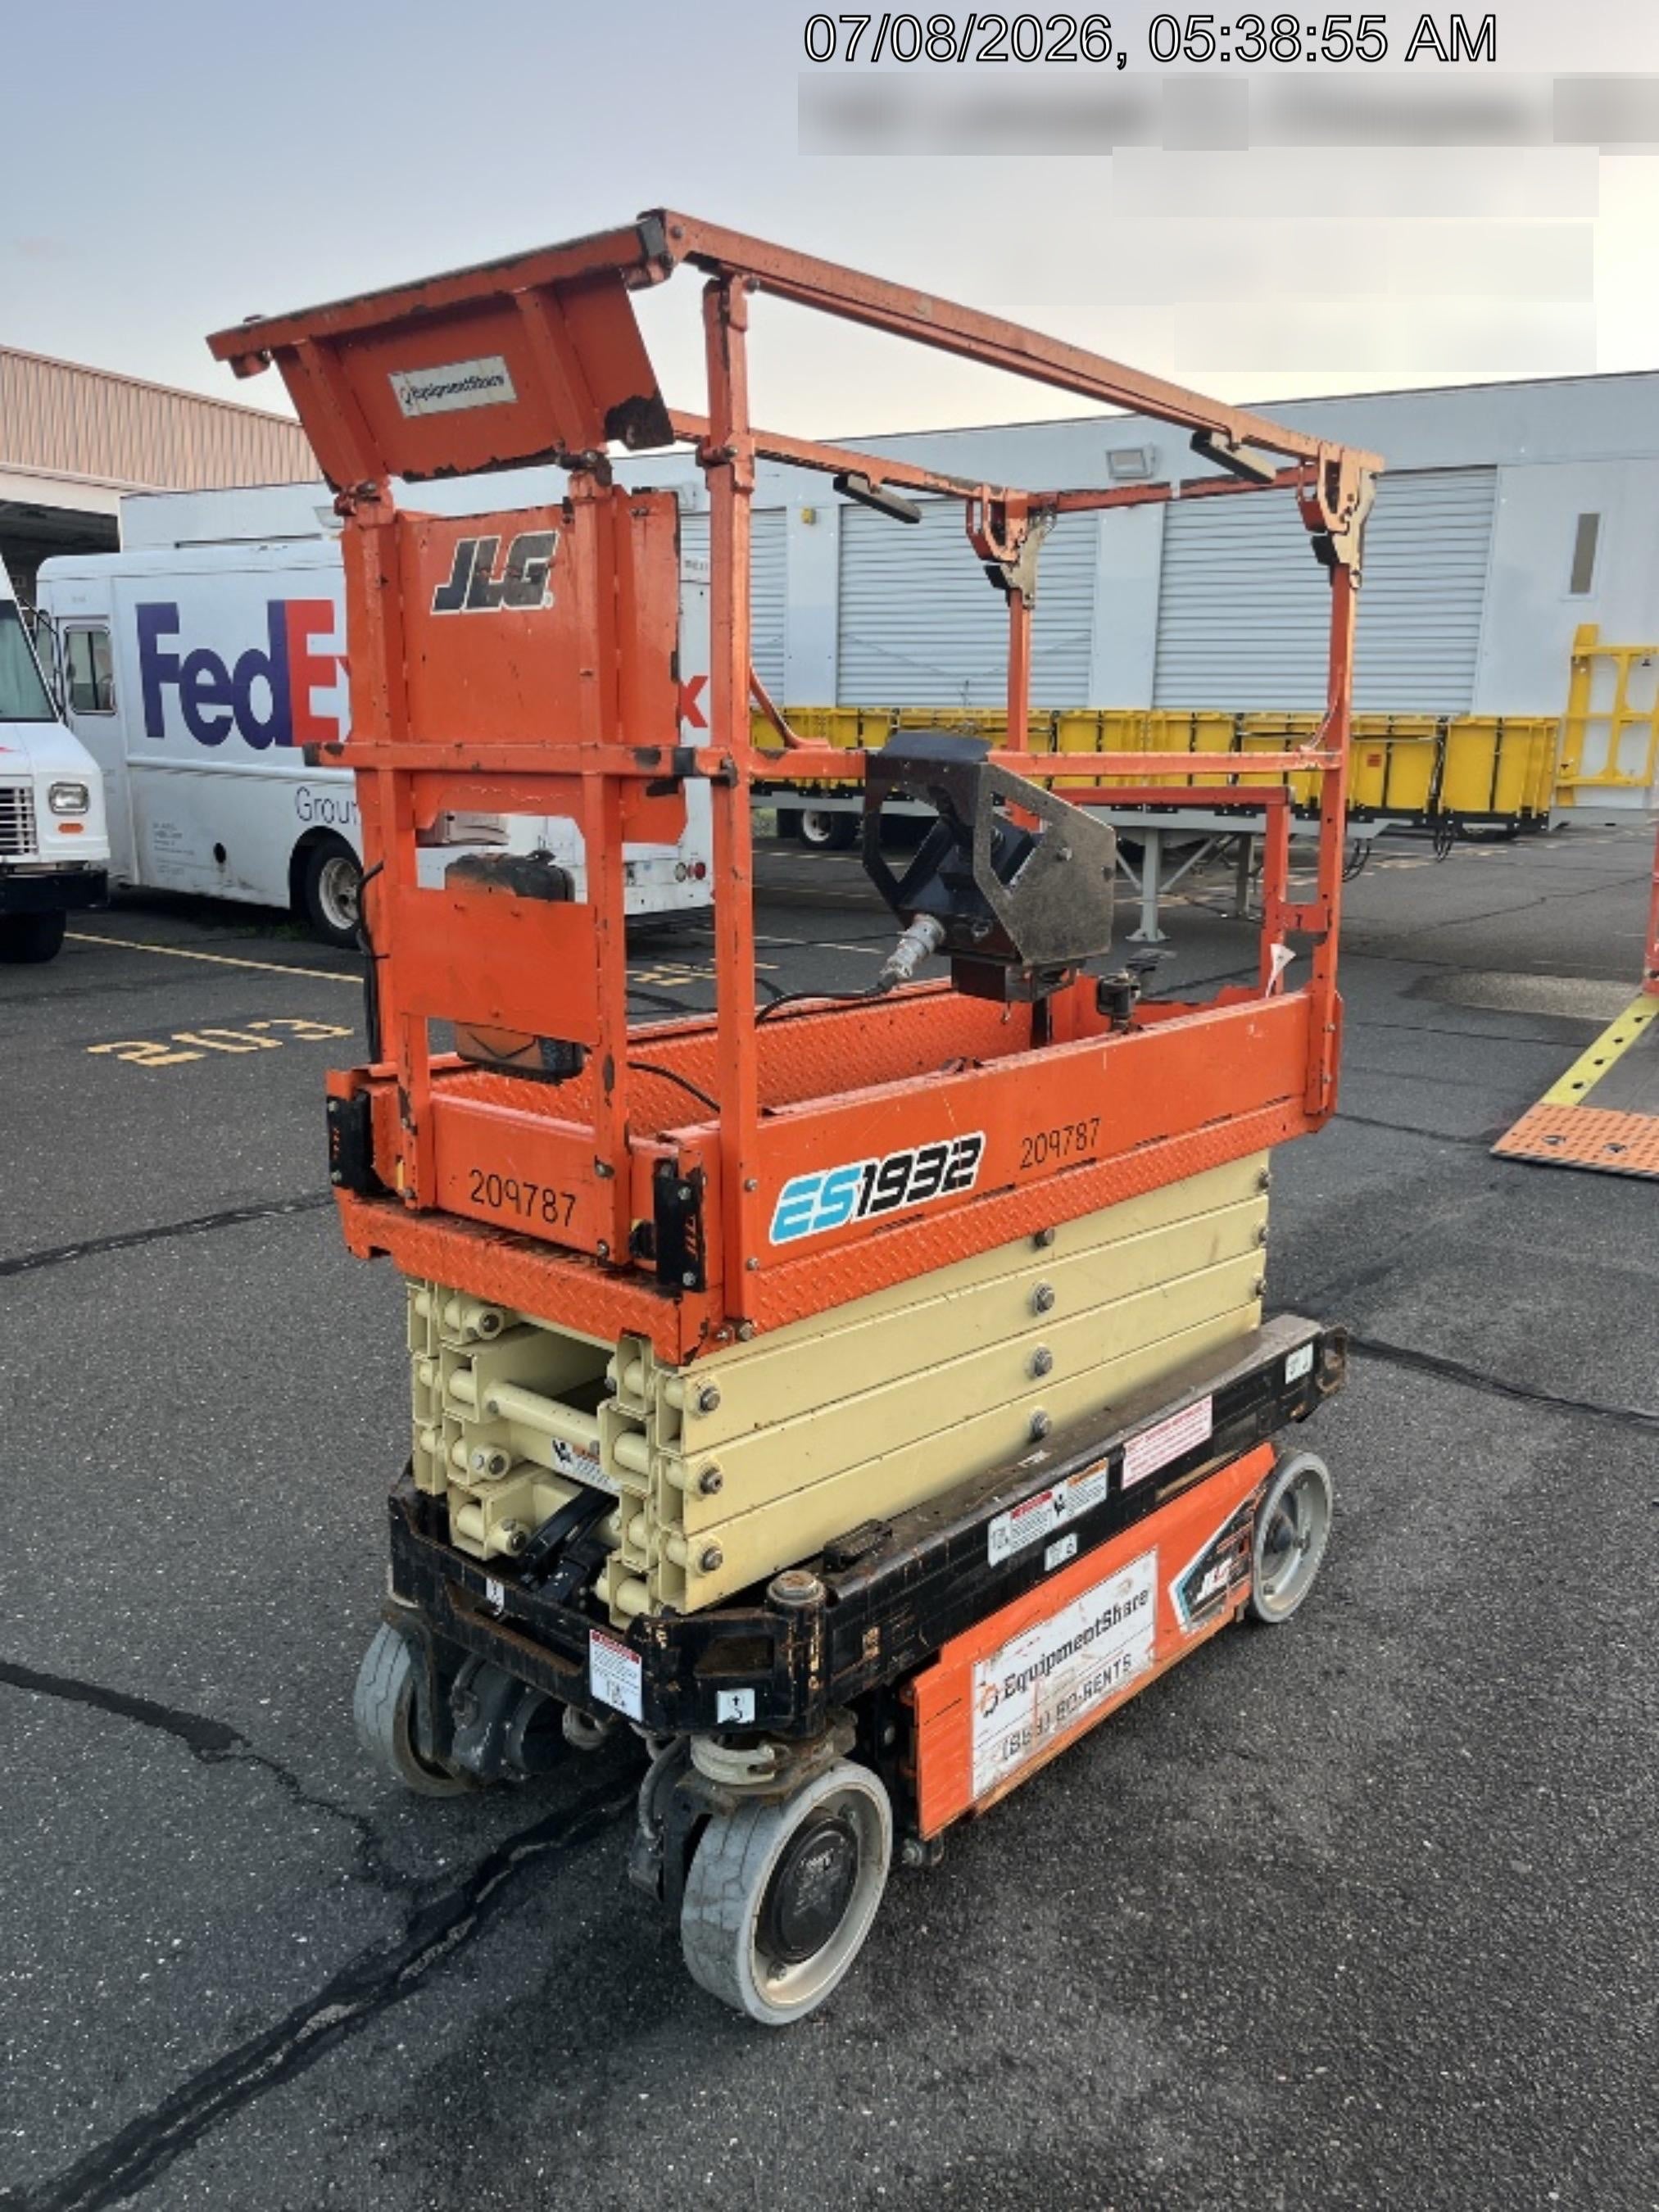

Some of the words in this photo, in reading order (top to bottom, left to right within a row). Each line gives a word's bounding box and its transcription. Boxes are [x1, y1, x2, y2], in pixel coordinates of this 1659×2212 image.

[432, 531, 559, 614] JLG
[135, 599, 351, 750] FedE
[87, 1019, 354, 1066] 203
[1019, 1117, 1100, 1170] 209787
[469, 1169, 576, 1227] 209787
[771, 1135, 984, 1243] ES1932
[1004, 1589, 1149, 1698] EquipmentShare
